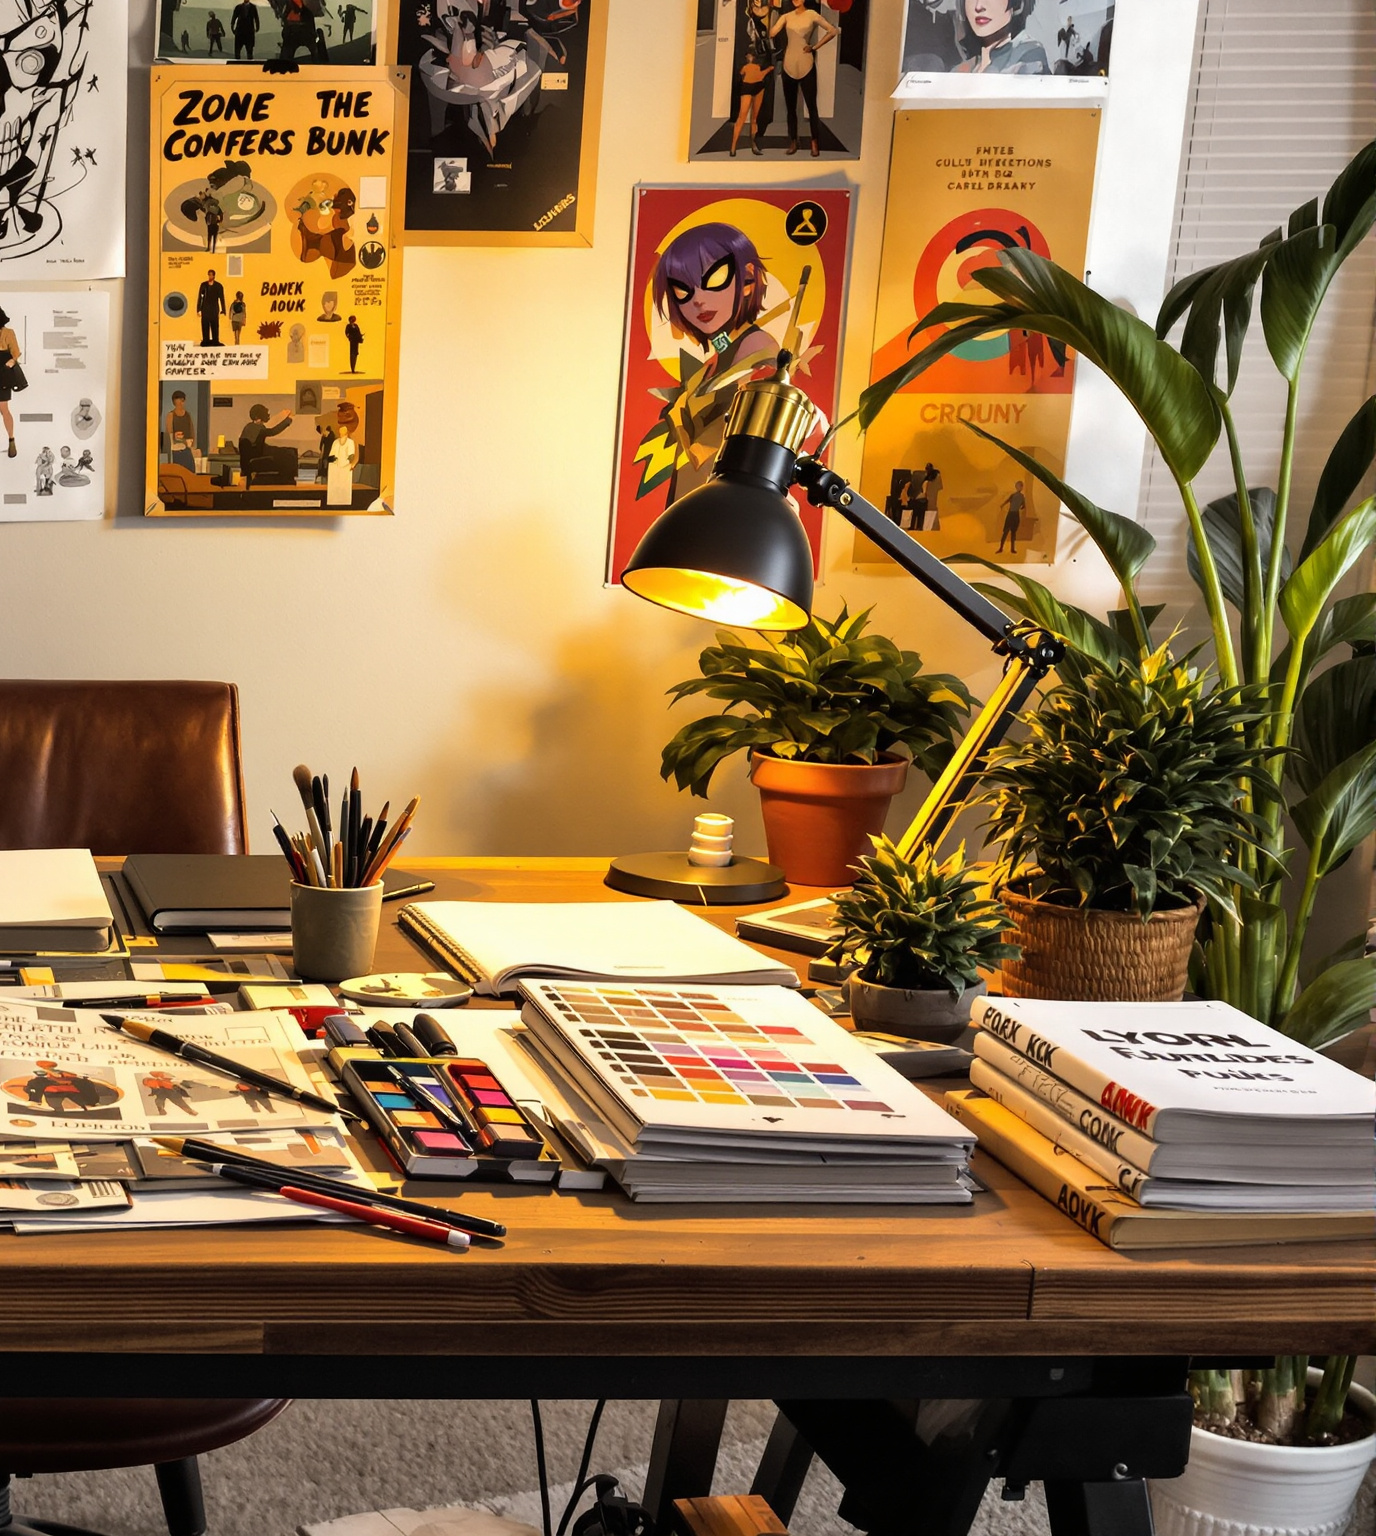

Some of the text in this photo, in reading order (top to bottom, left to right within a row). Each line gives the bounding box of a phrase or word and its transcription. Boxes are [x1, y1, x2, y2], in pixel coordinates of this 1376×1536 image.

[173, 90, 372, 126] ZONE THE
[163, 126, 390, 161] CONFERS BUNK
[920, 403, 1027, 424] CROUNY
